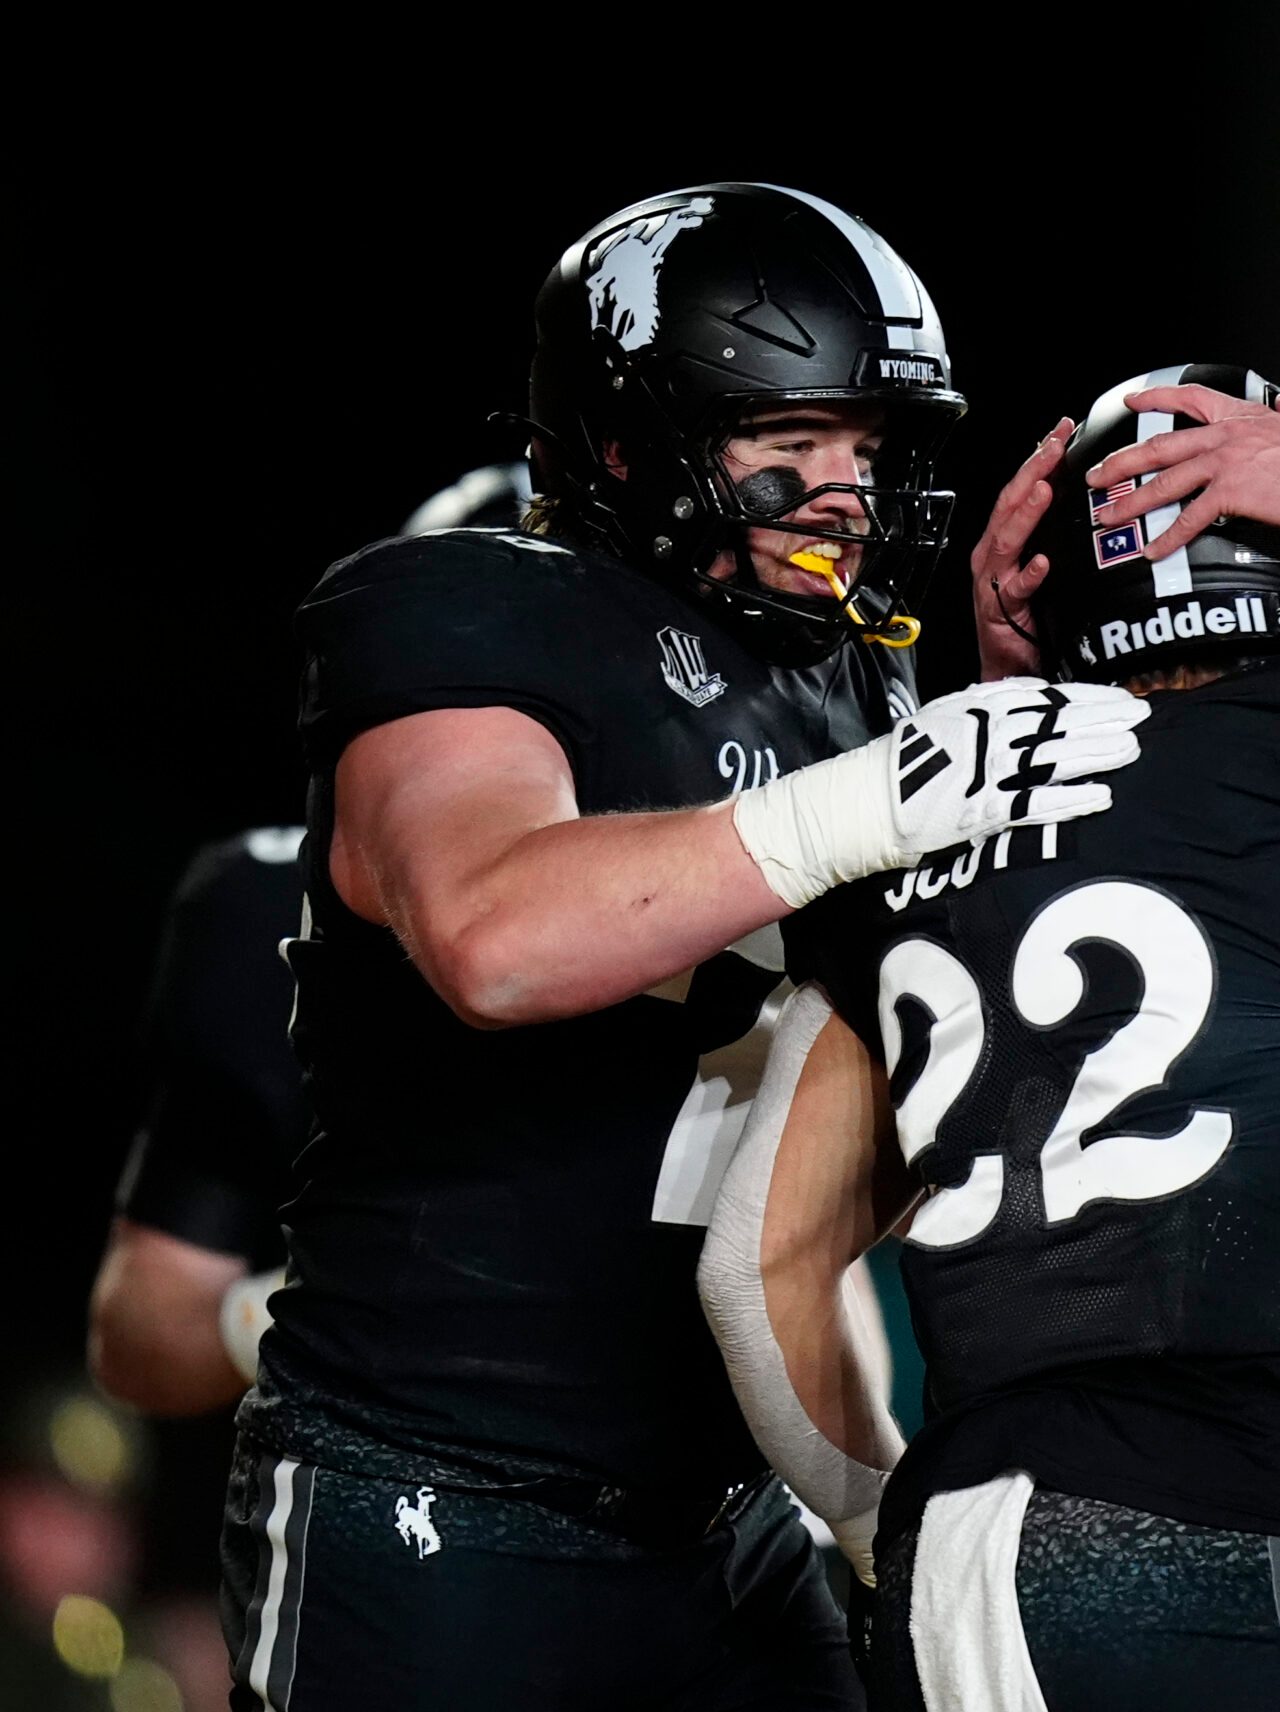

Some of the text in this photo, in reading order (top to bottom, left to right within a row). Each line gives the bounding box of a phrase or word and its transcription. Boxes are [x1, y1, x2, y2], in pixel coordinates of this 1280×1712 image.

[878, 359, 935, 382] WYOMING
[1100, 597, 1268, 660] Riddell
[878, 880, 1235, 1248] 22
